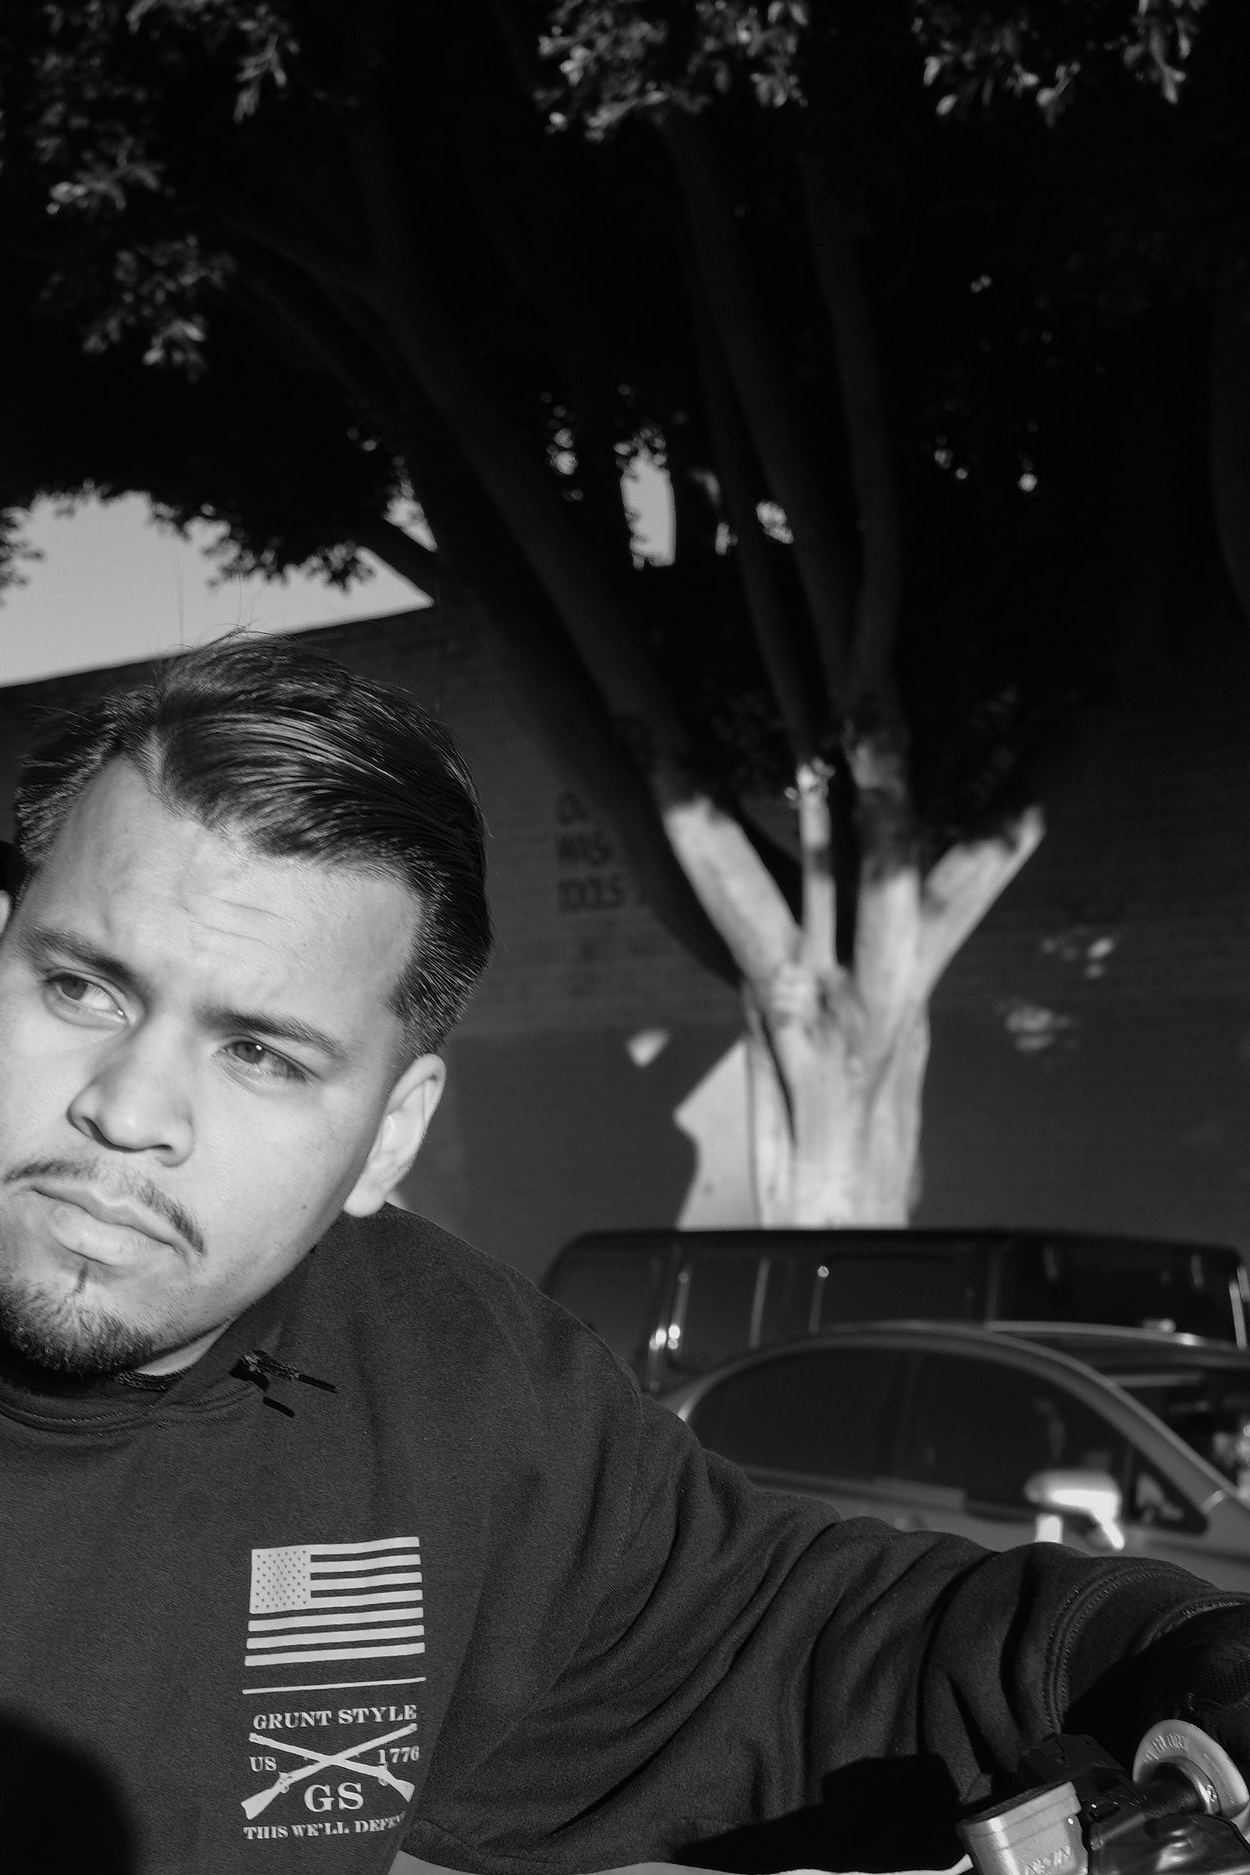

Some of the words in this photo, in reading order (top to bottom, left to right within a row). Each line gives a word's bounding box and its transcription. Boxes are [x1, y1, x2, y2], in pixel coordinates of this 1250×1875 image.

[253, 1710, 333, 1730] GRUNT
[338, 1704, 418, 1724] STYLE
[250, 1756, 277, 1772] US
[378, 1745, 420, 1765] 1776
[304, 1782, 364, 1812] GS
[243, 1826, 289, 1840] THIS
[291, 1821, 350, 1838] WE'LL
